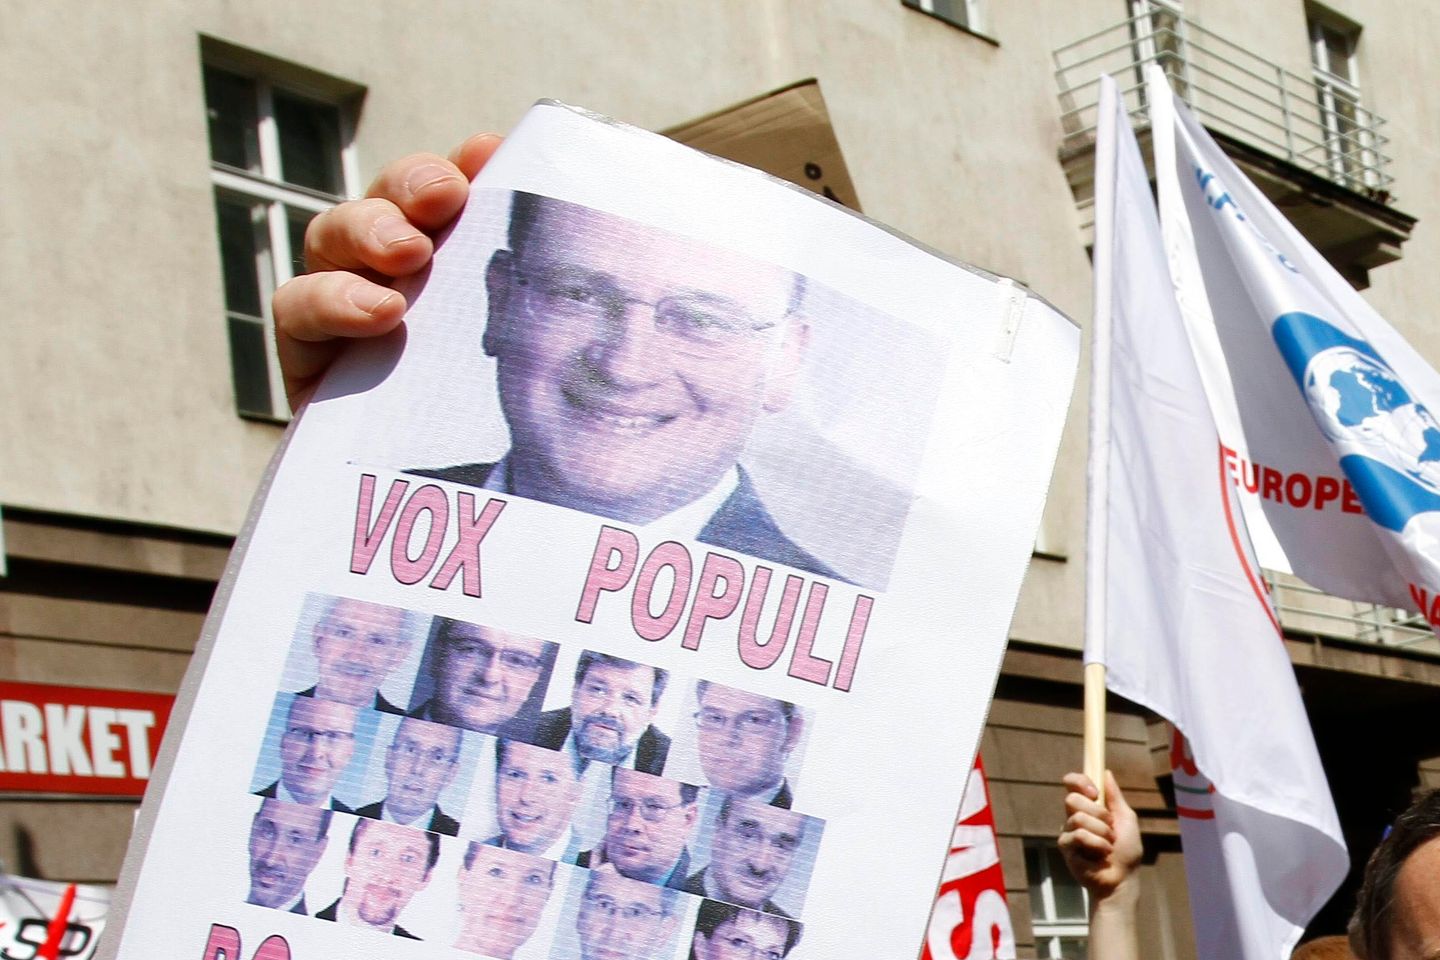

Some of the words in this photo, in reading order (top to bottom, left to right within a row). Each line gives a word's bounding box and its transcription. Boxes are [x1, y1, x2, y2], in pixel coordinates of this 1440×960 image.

[349, 473, 507, 598] VOX
[574, 524, 875, 693] POPULI
[0, 700, 155, 780] RKET
